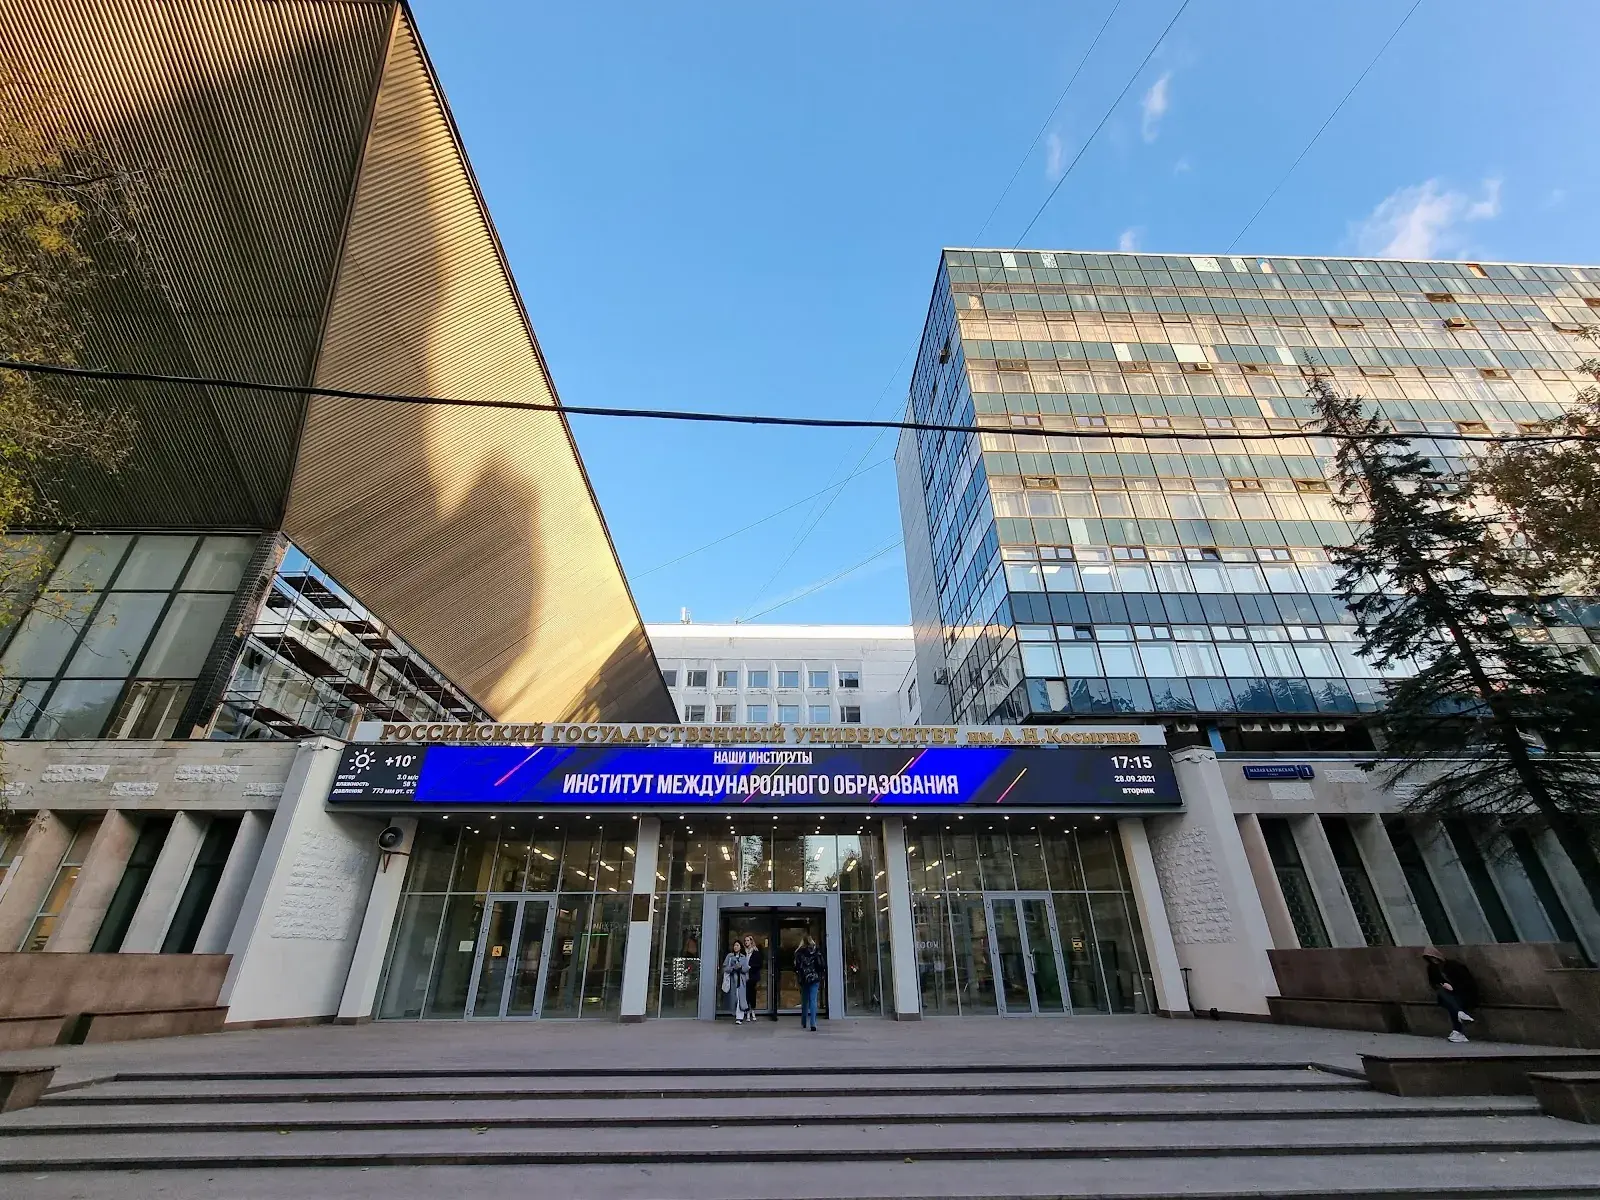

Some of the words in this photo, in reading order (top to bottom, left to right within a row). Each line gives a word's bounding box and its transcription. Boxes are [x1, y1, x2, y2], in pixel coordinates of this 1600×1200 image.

[379, 721, 546, 741] РОССИЙСКИЙ
[550, 722, 787, 743] ГОСУДАРСТВЕННЫЙ
[794, 726, 959, 744] УНИВЕРСИТЕТ
[713, 750, 748, 764] НАШИ
[750, 751, 813, 764] ИНСТИТУТЫ
[1111, 755, 1153, 769] 17:15
[1304, 766, 1310, 776] 1
[563, 774, 653, 795] ИНСТИТУТ
[656, 774, 829, 797] МЕЖДУНАРОДНОГО
[833, 774, 959, 795] ОБРАЗОВАНИЯ
[1114, 775, 1156, 783] 28.09.2021
[1122, 787, 1155, 796] вторник
